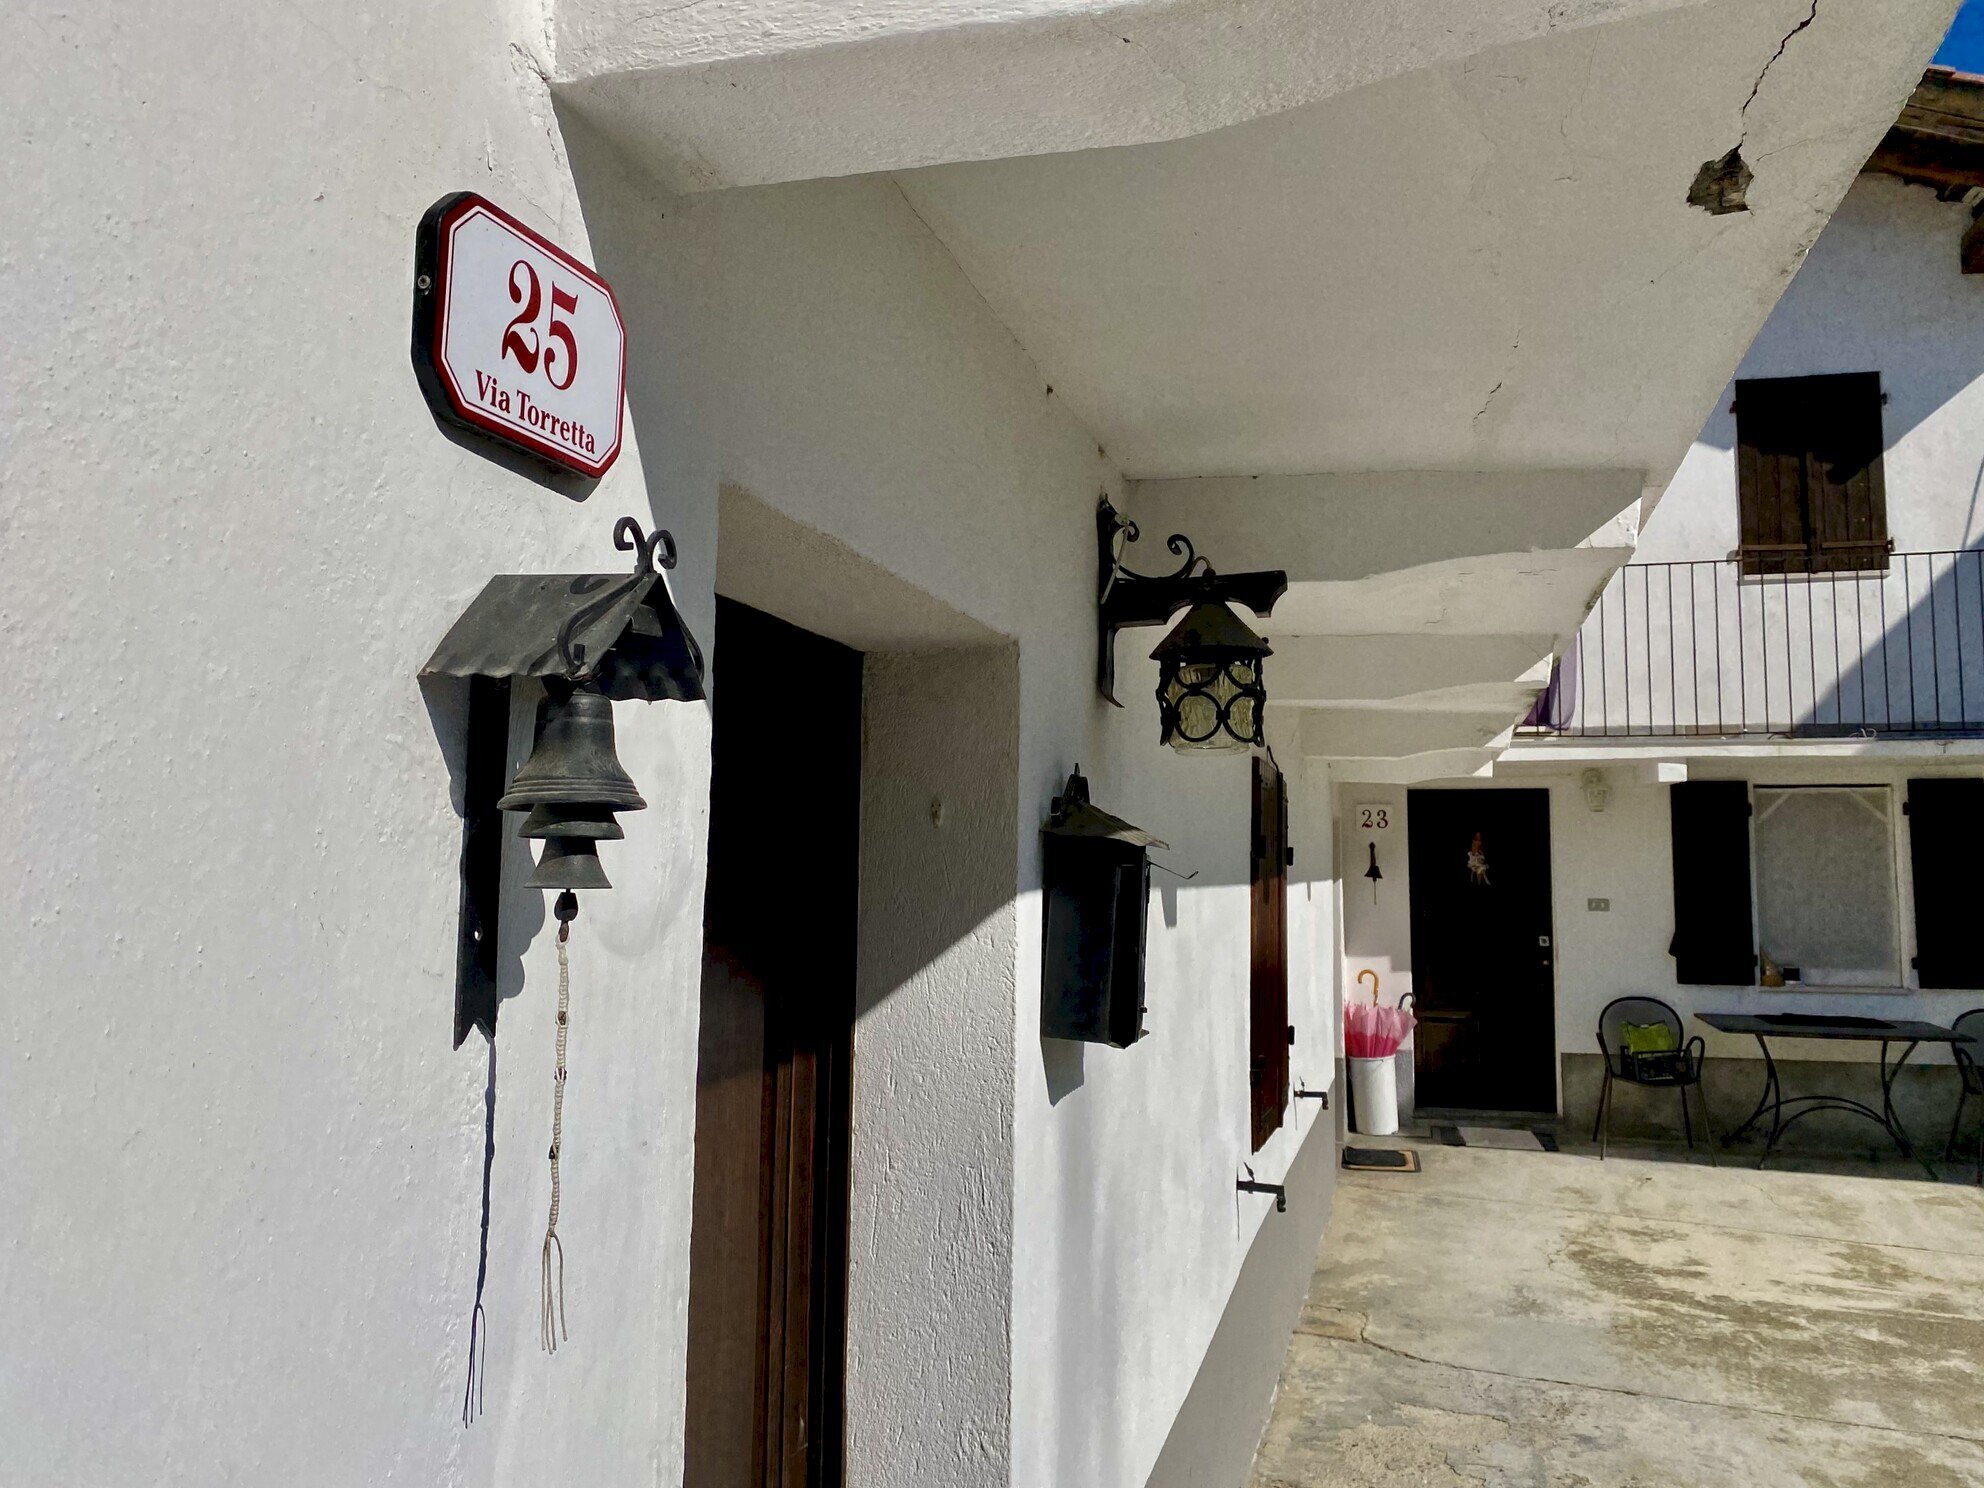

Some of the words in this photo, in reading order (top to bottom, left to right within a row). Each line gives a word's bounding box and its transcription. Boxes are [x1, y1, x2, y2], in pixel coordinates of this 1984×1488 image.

[502, 259, 579, 390] 25
[475, 369, 511, 414] Via
[516, 389, 596, 455] Torretta
[1361, 809, 1388, 829] 23
